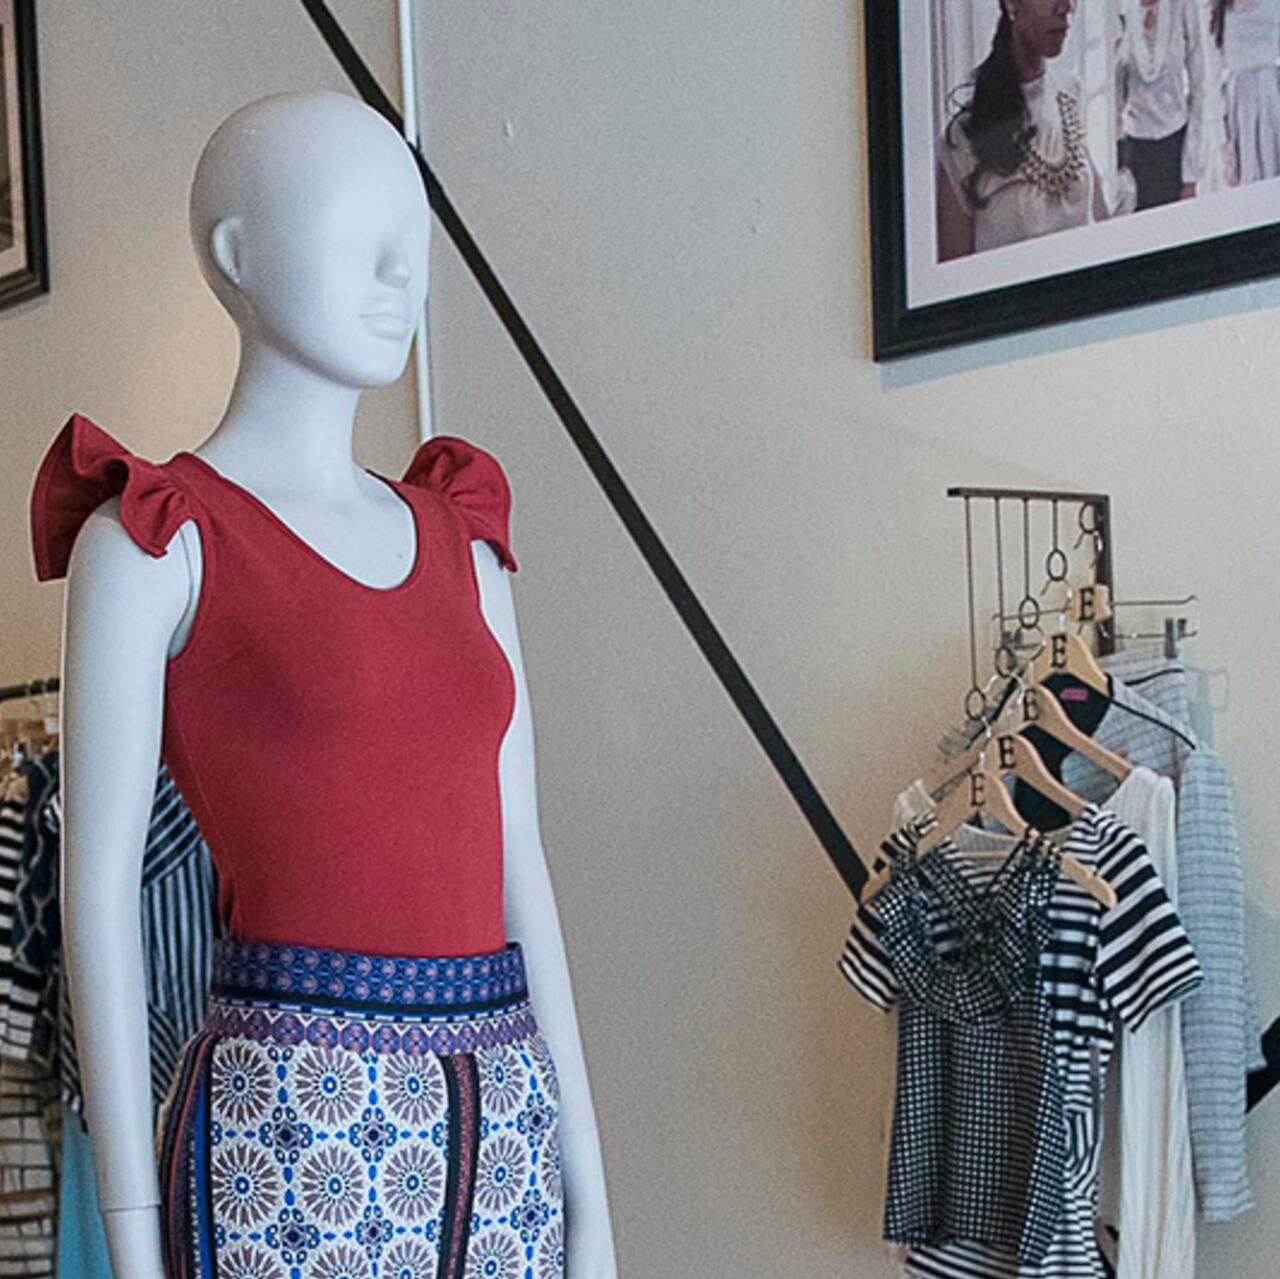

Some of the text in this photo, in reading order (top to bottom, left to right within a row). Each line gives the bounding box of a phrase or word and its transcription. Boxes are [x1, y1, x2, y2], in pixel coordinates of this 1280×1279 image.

[1079, 586, 1095, 621] E
[1051, 633, 1067, 668] E
[1023, 688, 1040, 721] E
[998, 735, 1016, 769] E
[970, 772, 985, 806] E
